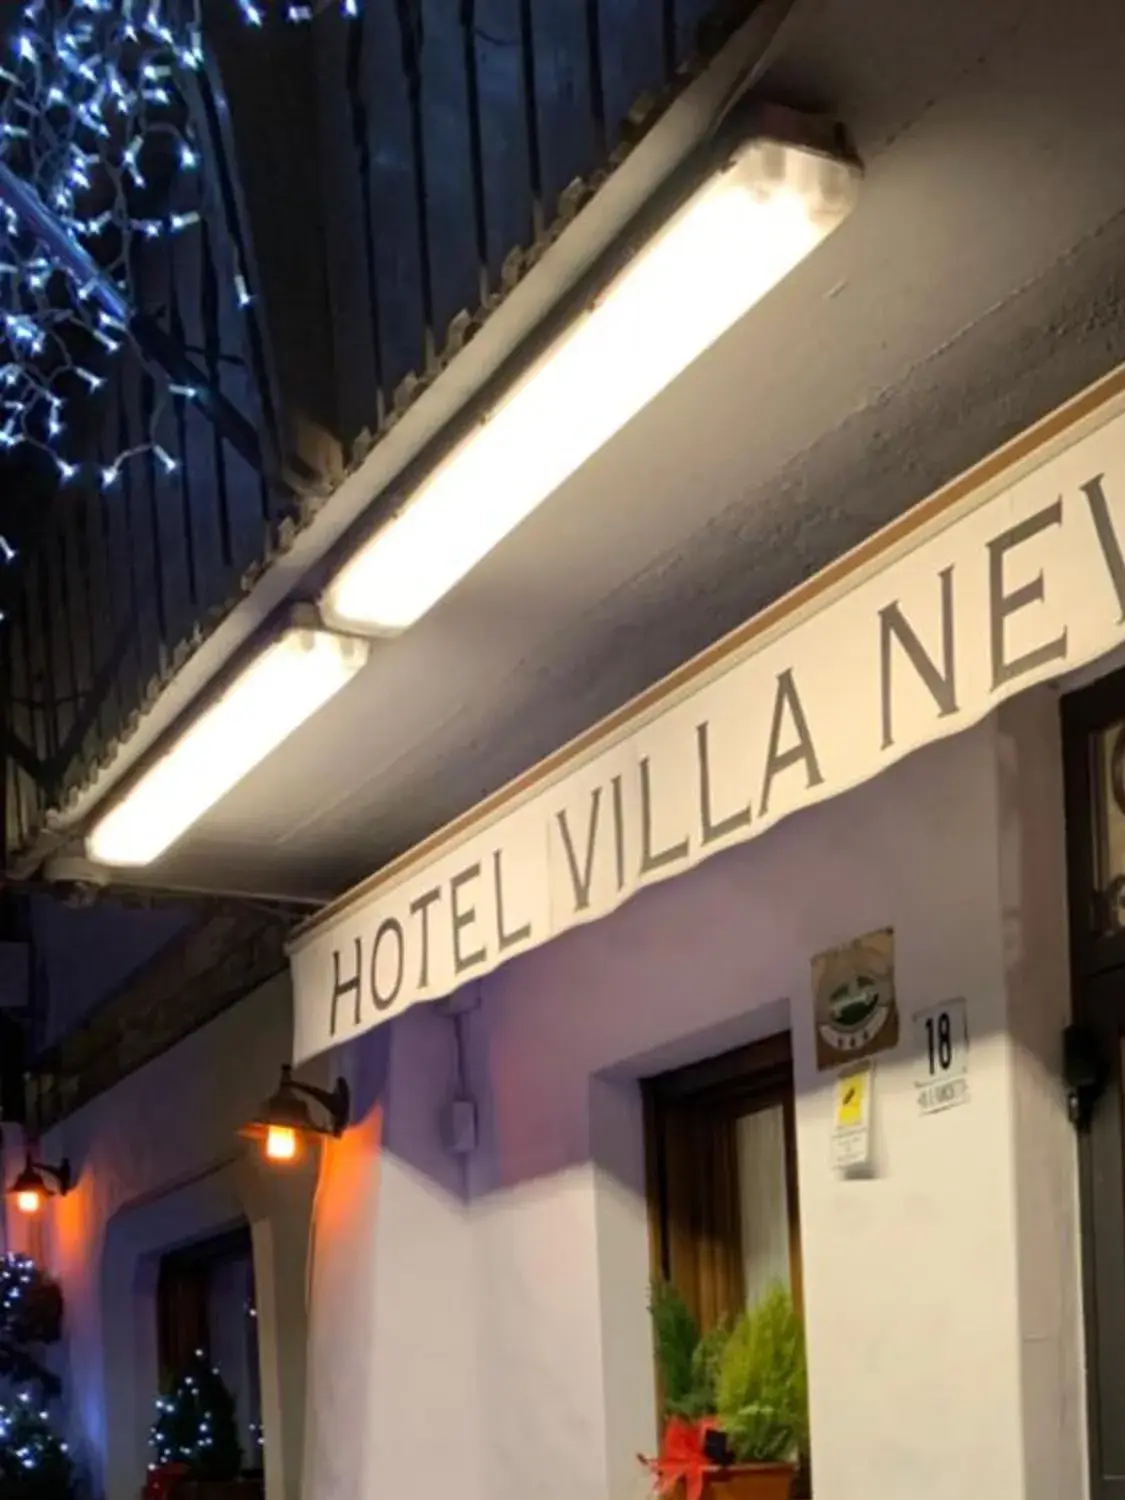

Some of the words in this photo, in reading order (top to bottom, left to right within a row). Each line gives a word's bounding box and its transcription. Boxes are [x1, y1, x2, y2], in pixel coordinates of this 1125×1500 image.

[329, 847, 532, 1037] HOTEL
[555, 667, 826, 911] VILLA
[925, 1012, 952, 1075] 18
